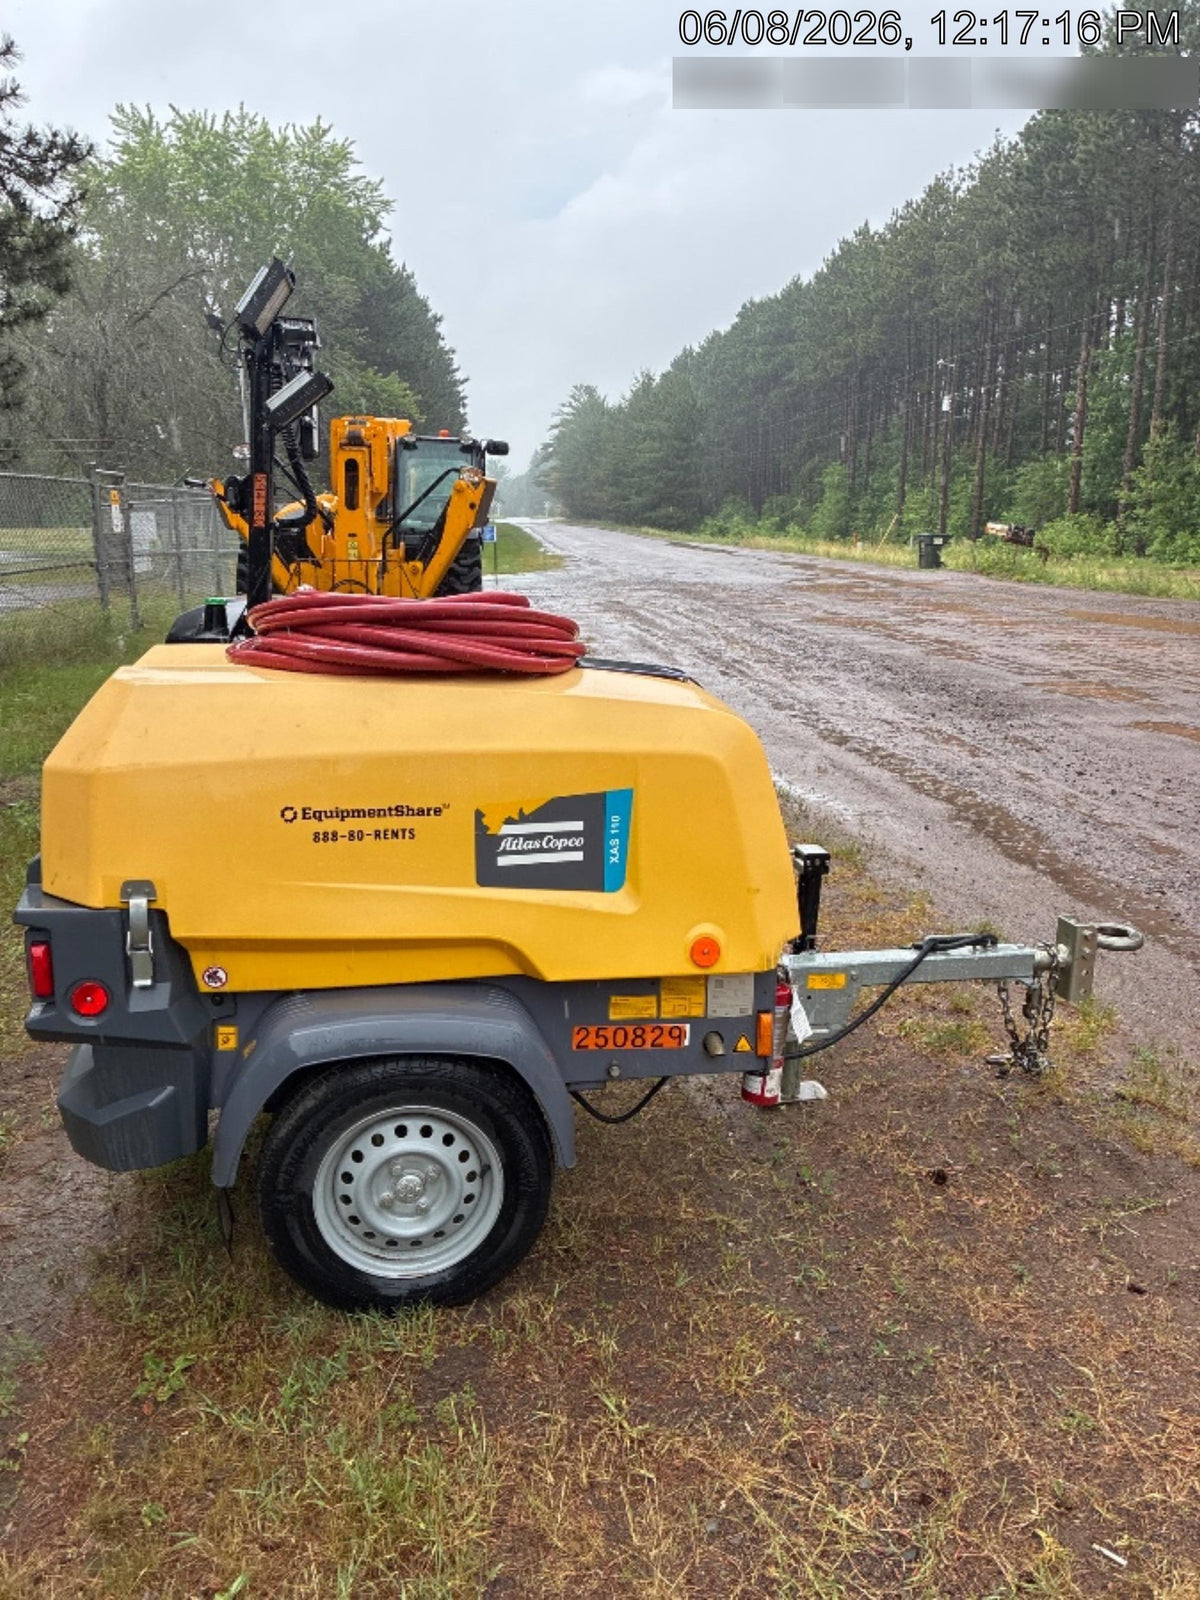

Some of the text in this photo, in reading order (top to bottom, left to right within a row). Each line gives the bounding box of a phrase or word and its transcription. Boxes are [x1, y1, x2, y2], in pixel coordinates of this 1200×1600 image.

[301, 804, 443, 822] EquipmentShare
[312, 827, 416, 844] 888-80-RENTS
[496, 834, 584, 853] Atlas Copco
[609, 815, 621, 865] XAS 110
[575, 1025, 683, 1050] 250829
